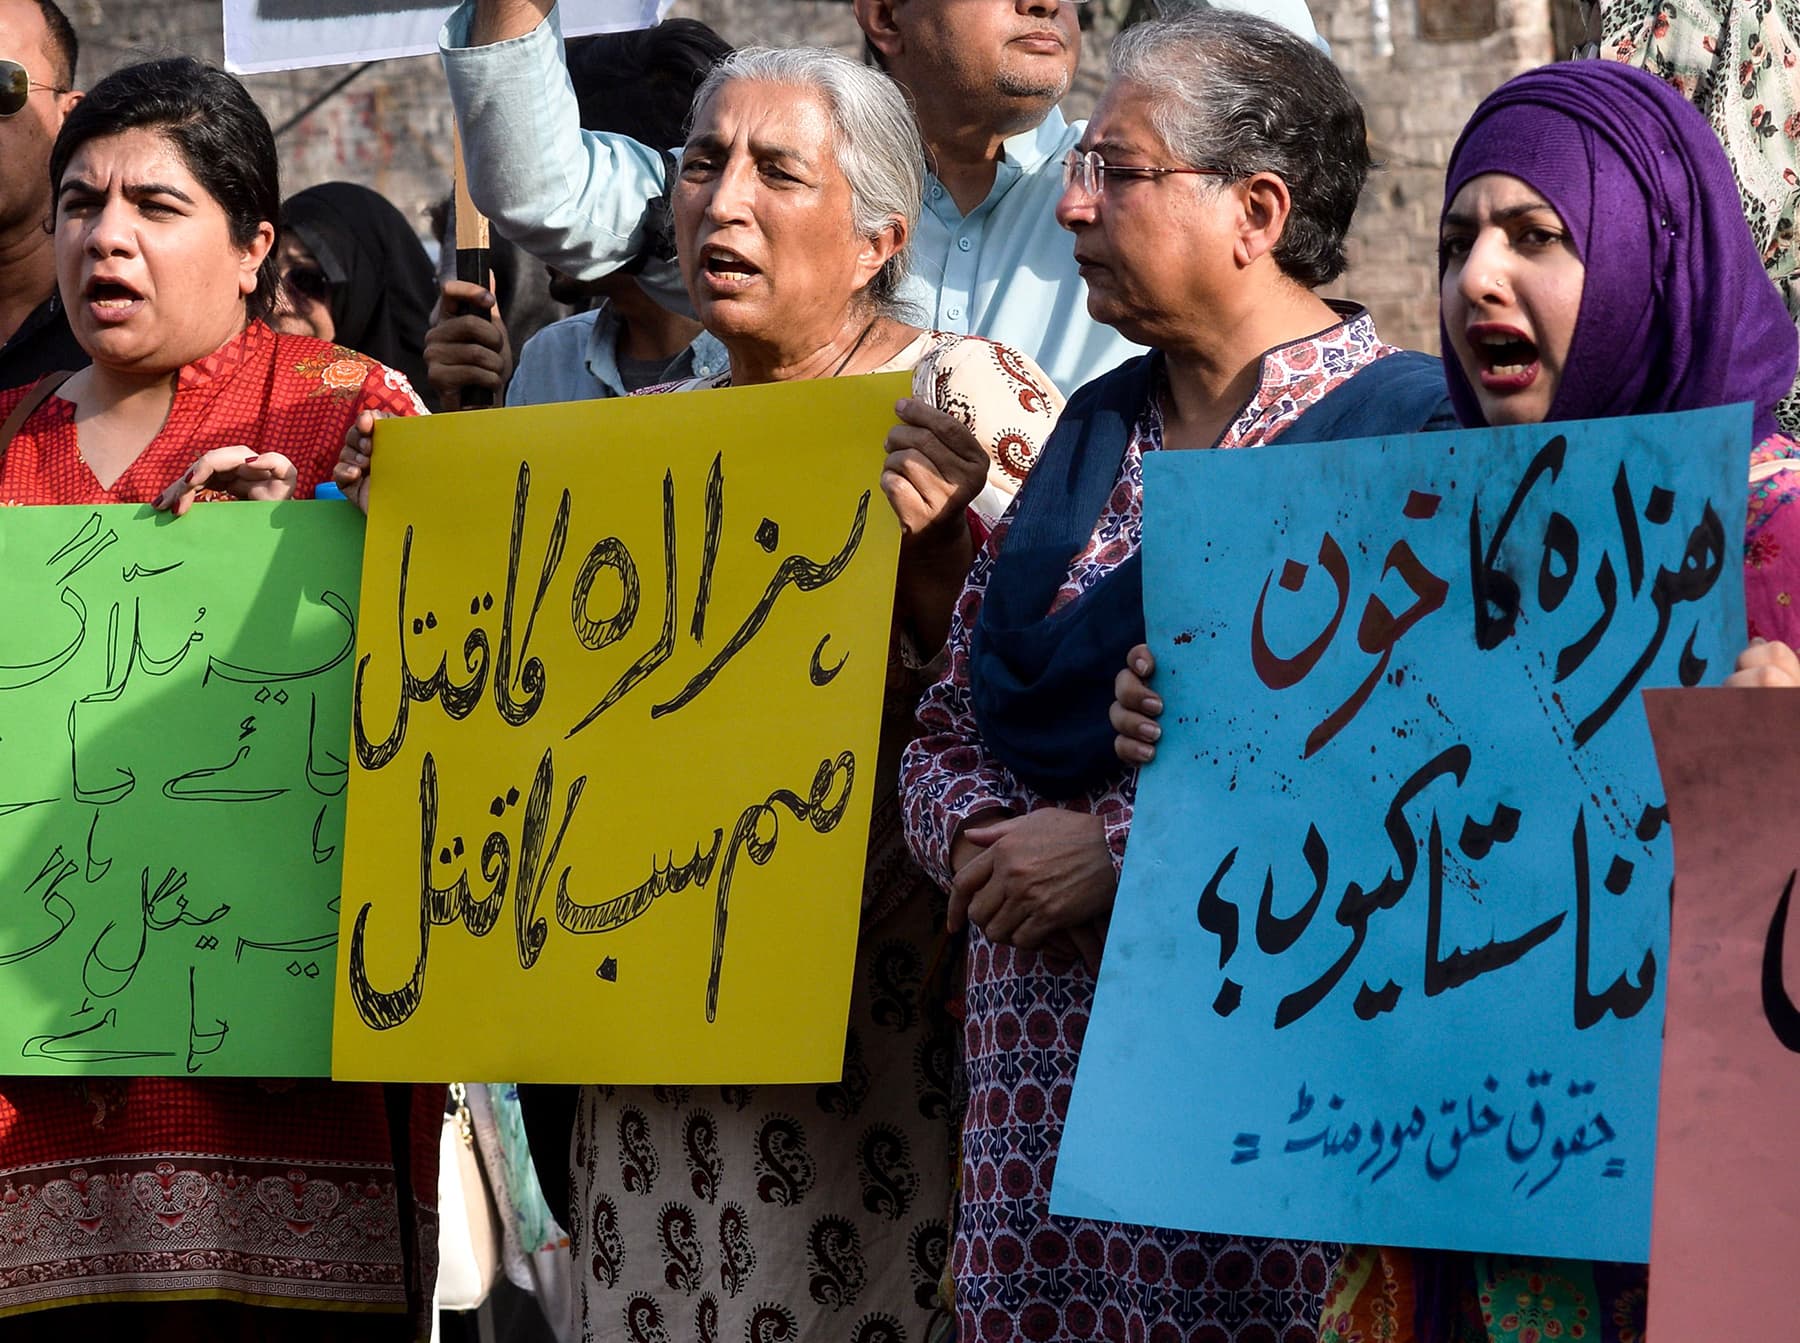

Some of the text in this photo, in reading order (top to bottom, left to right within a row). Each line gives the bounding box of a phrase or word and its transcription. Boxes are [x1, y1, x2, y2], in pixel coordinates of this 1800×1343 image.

[355, 525, 493, 770] قتل
[494, 461, 572, 727] کا
[566, 450, 872, 740] ہزارہ
[1251, 435, 1727, 760] ہزارہ کا خون
[349, 752, 520, 1031] قتل
[515, 747, 587, 970] کا
[557, 828, 722, 983] سب
[1425, 1074, 1503, 1182] خلق
